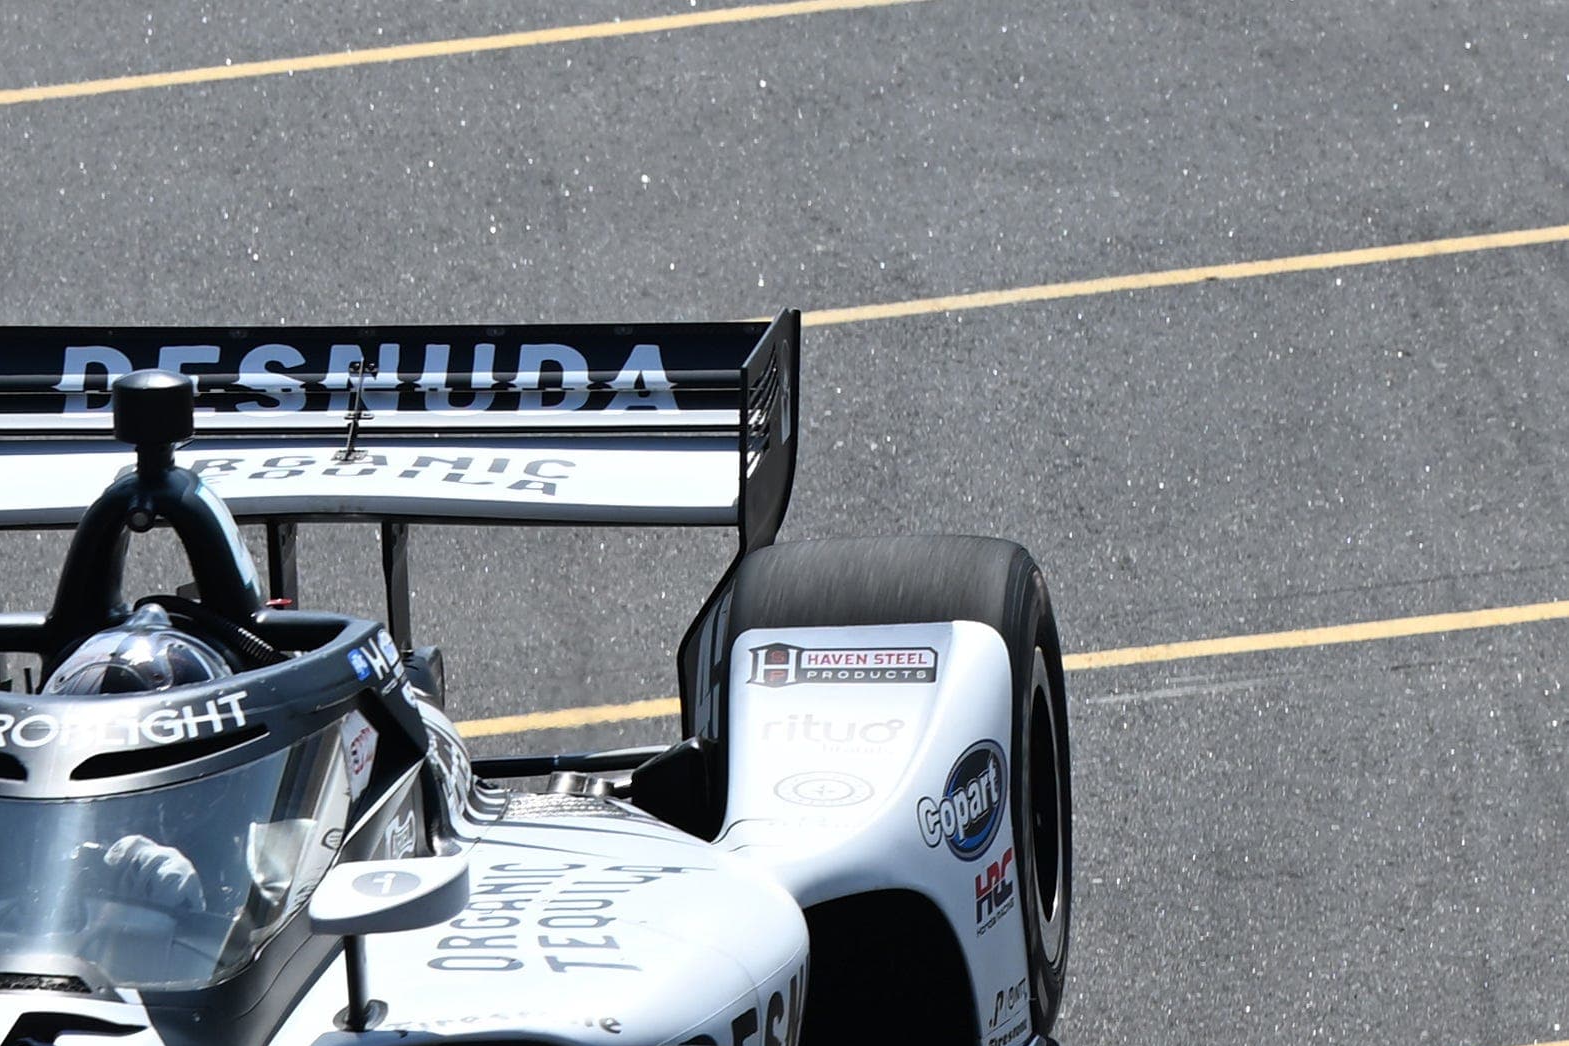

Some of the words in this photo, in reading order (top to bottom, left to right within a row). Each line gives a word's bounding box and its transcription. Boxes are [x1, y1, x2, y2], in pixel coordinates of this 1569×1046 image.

[53, 343, 683, 417] DESNUDA
[169, 454, 578, 480] RGANIC
[806, 670, 927, 679] PRODUCTS
[807, 653, 868, 665] HAVEN
[874, 653, 928, 665] STEEL
[917, 751, 1001, 848] Copart
[426, 861, 587, 972] ORGANIC
[537, 864, 719, 974] TEQUILA
